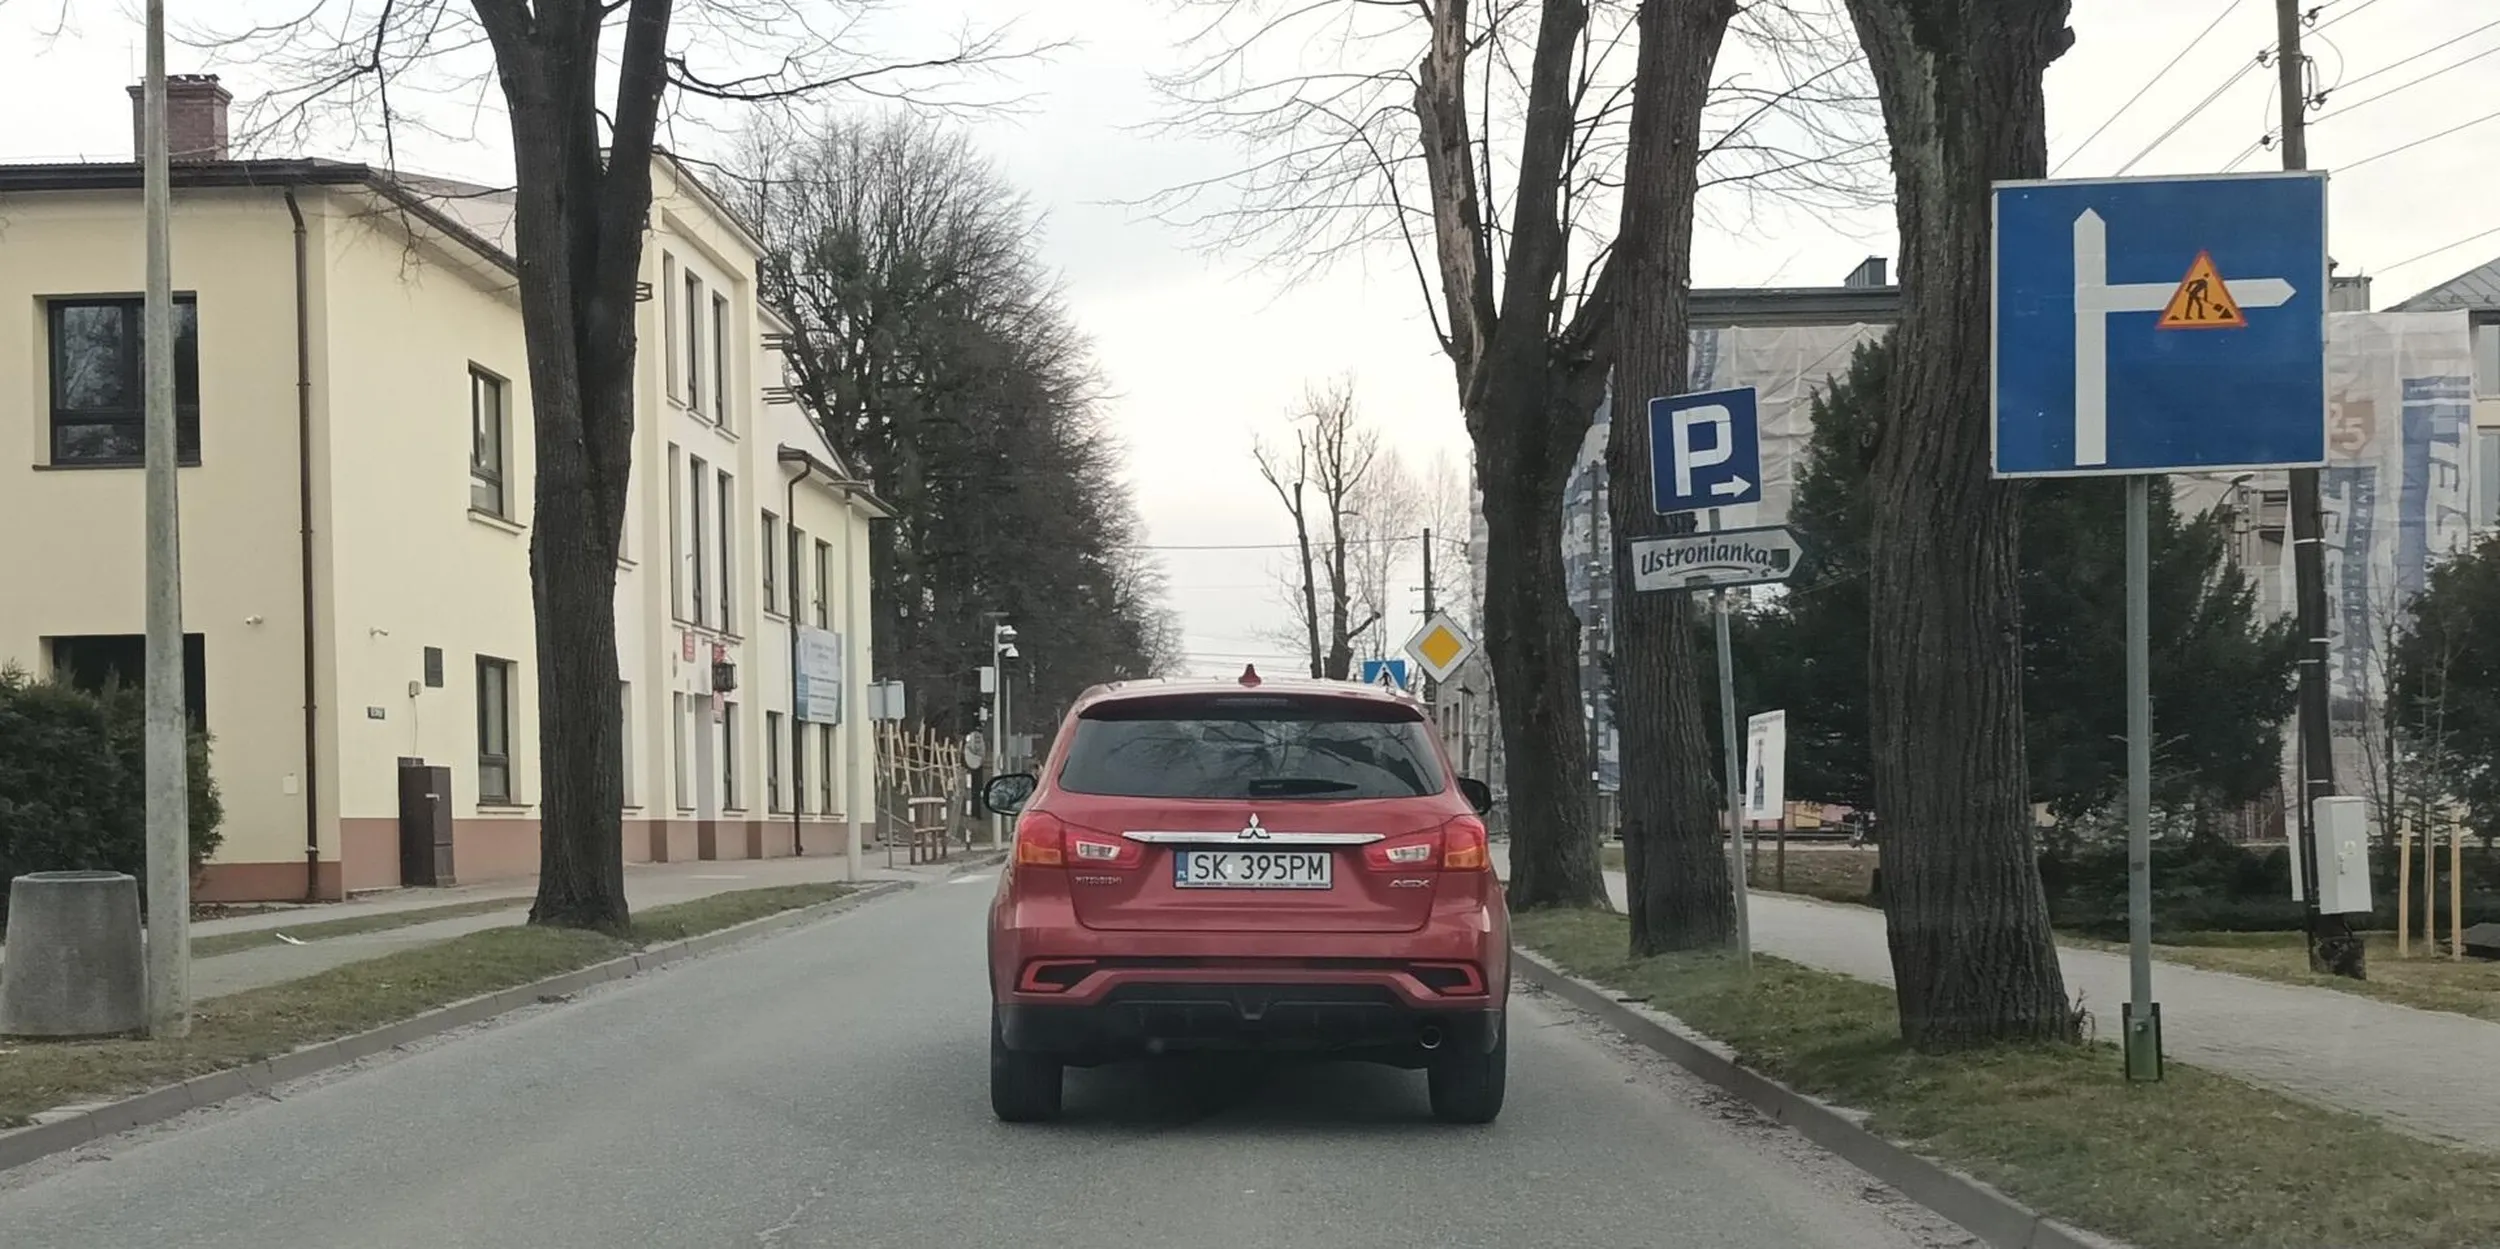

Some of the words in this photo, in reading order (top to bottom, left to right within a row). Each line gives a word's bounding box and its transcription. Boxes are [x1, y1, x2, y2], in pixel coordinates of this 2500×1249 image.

[1671, 404, 1733, 497] P
[1641, 537, 1768, 576] Ustronianka
[1194, 855, 1228, 880] SK
[1240, 855, 1324, 881] 395PM
